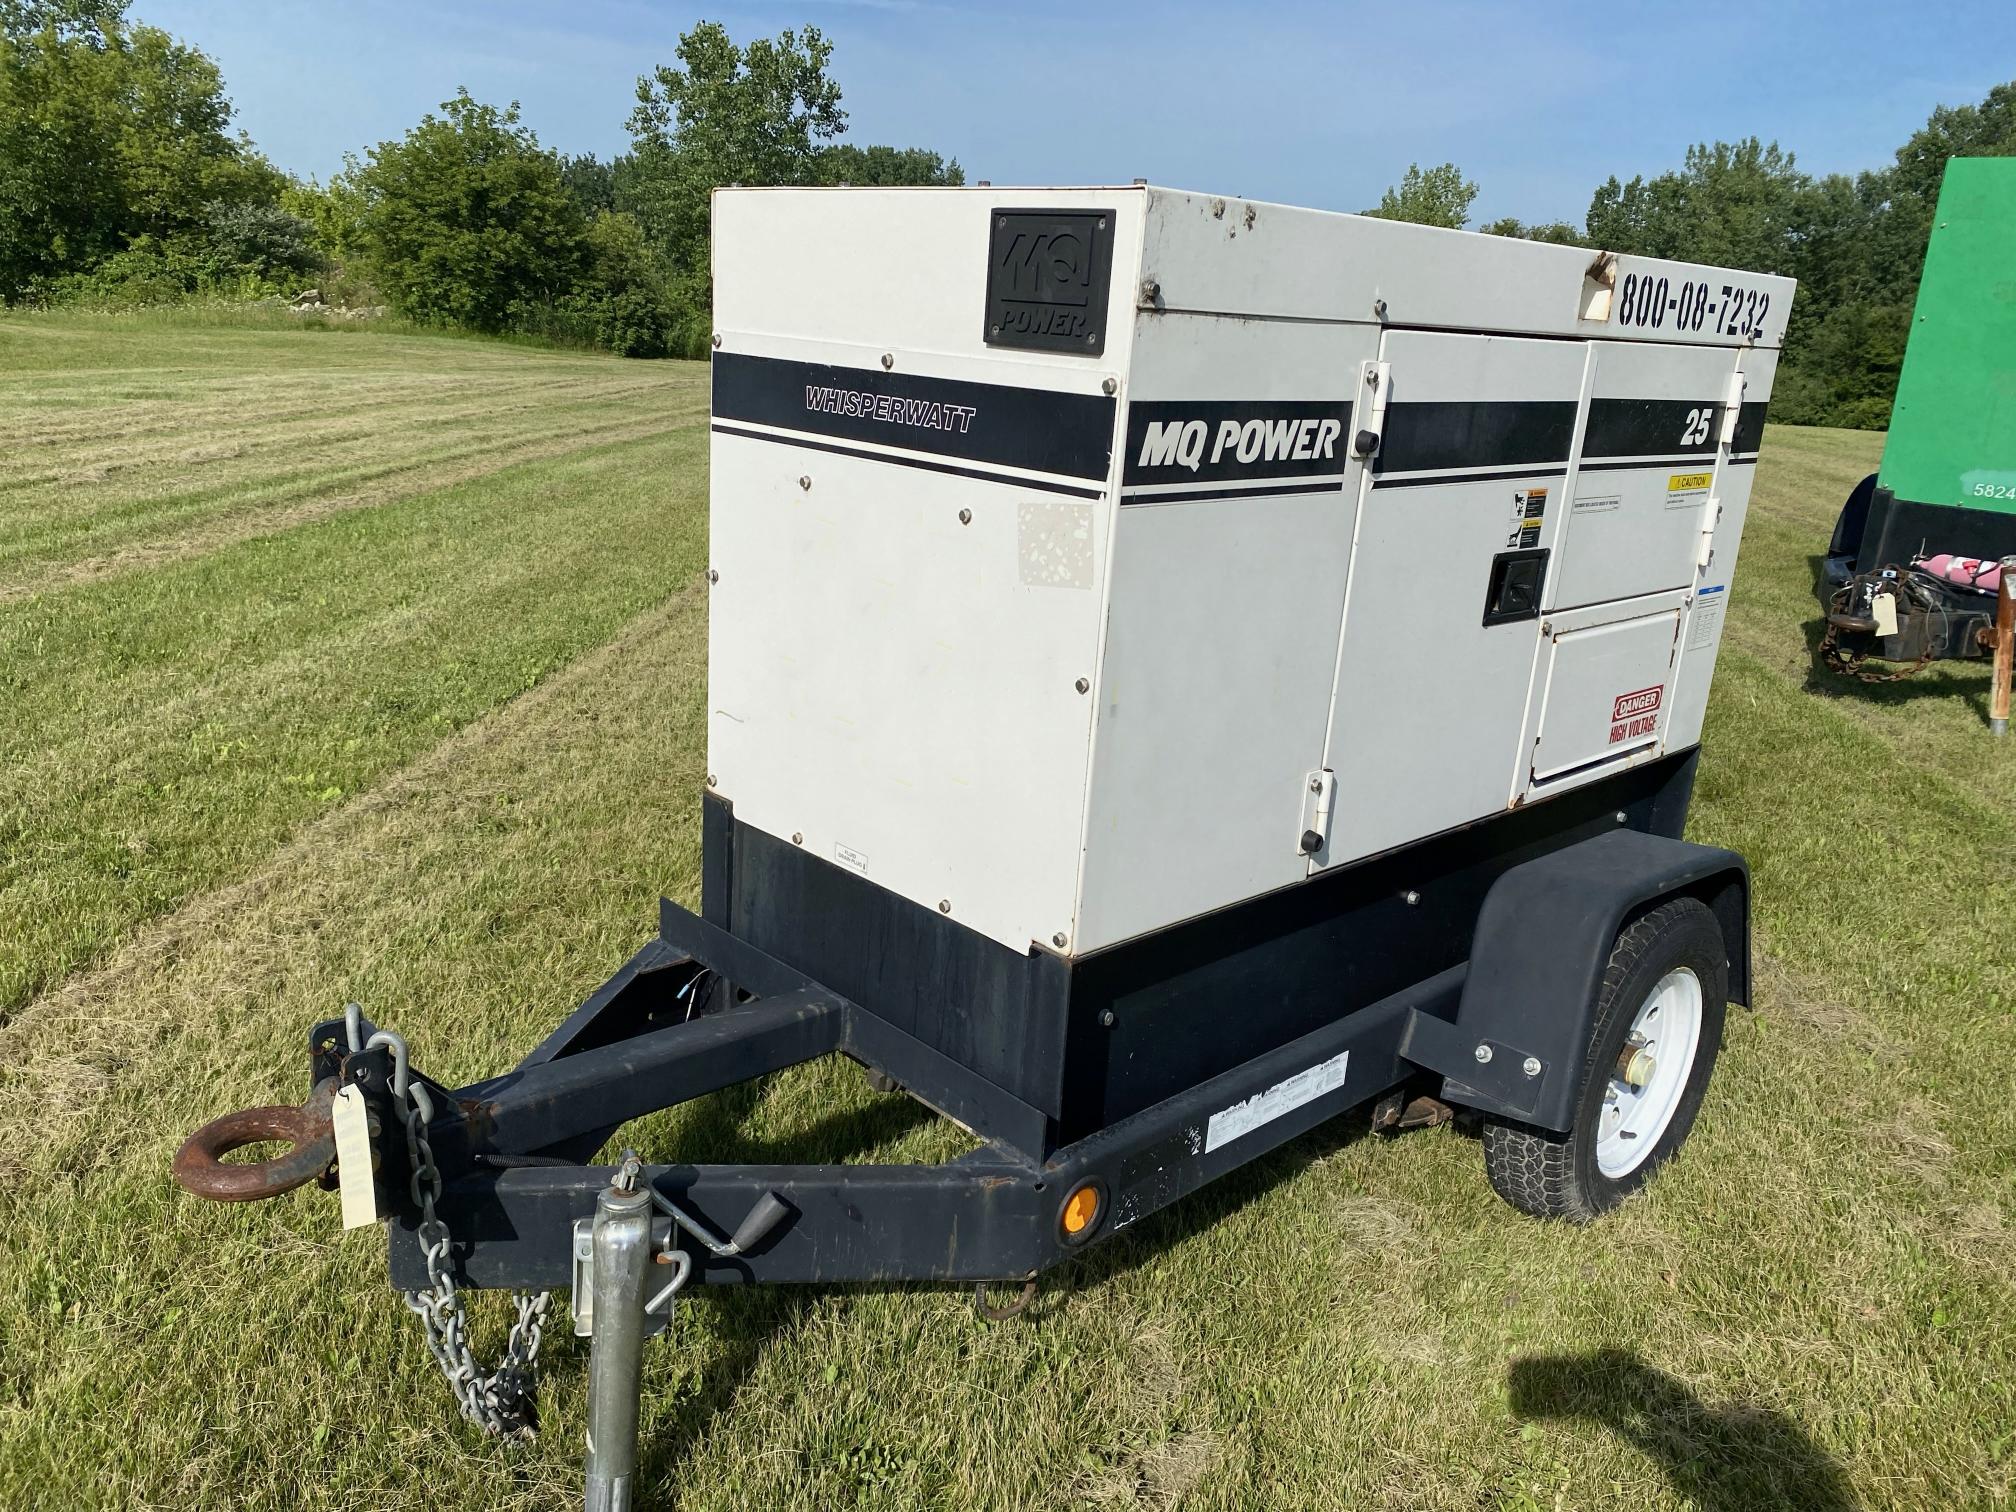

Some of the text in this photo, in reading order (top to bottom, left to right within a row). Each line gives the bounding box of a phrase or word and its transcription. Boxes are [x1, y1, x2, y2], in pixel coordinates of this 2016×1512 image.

[999, 306, 1087, 338] POWER
[1619, 273, 1770, 339] 800-08-7232
[806, 385, 977, 434] WHISPERWATT
[1680, 408, 1714, 446] 25
[1137, 419, 1342, 473] MQ POWER
[1681, 476, 1707, 488] CAUTION
[1973, 483, 2016, 500] 5824
[1619, 692, 1657, 715] DANGER
[1608, 713, 1658, 745] HIGH VOLTAGE
